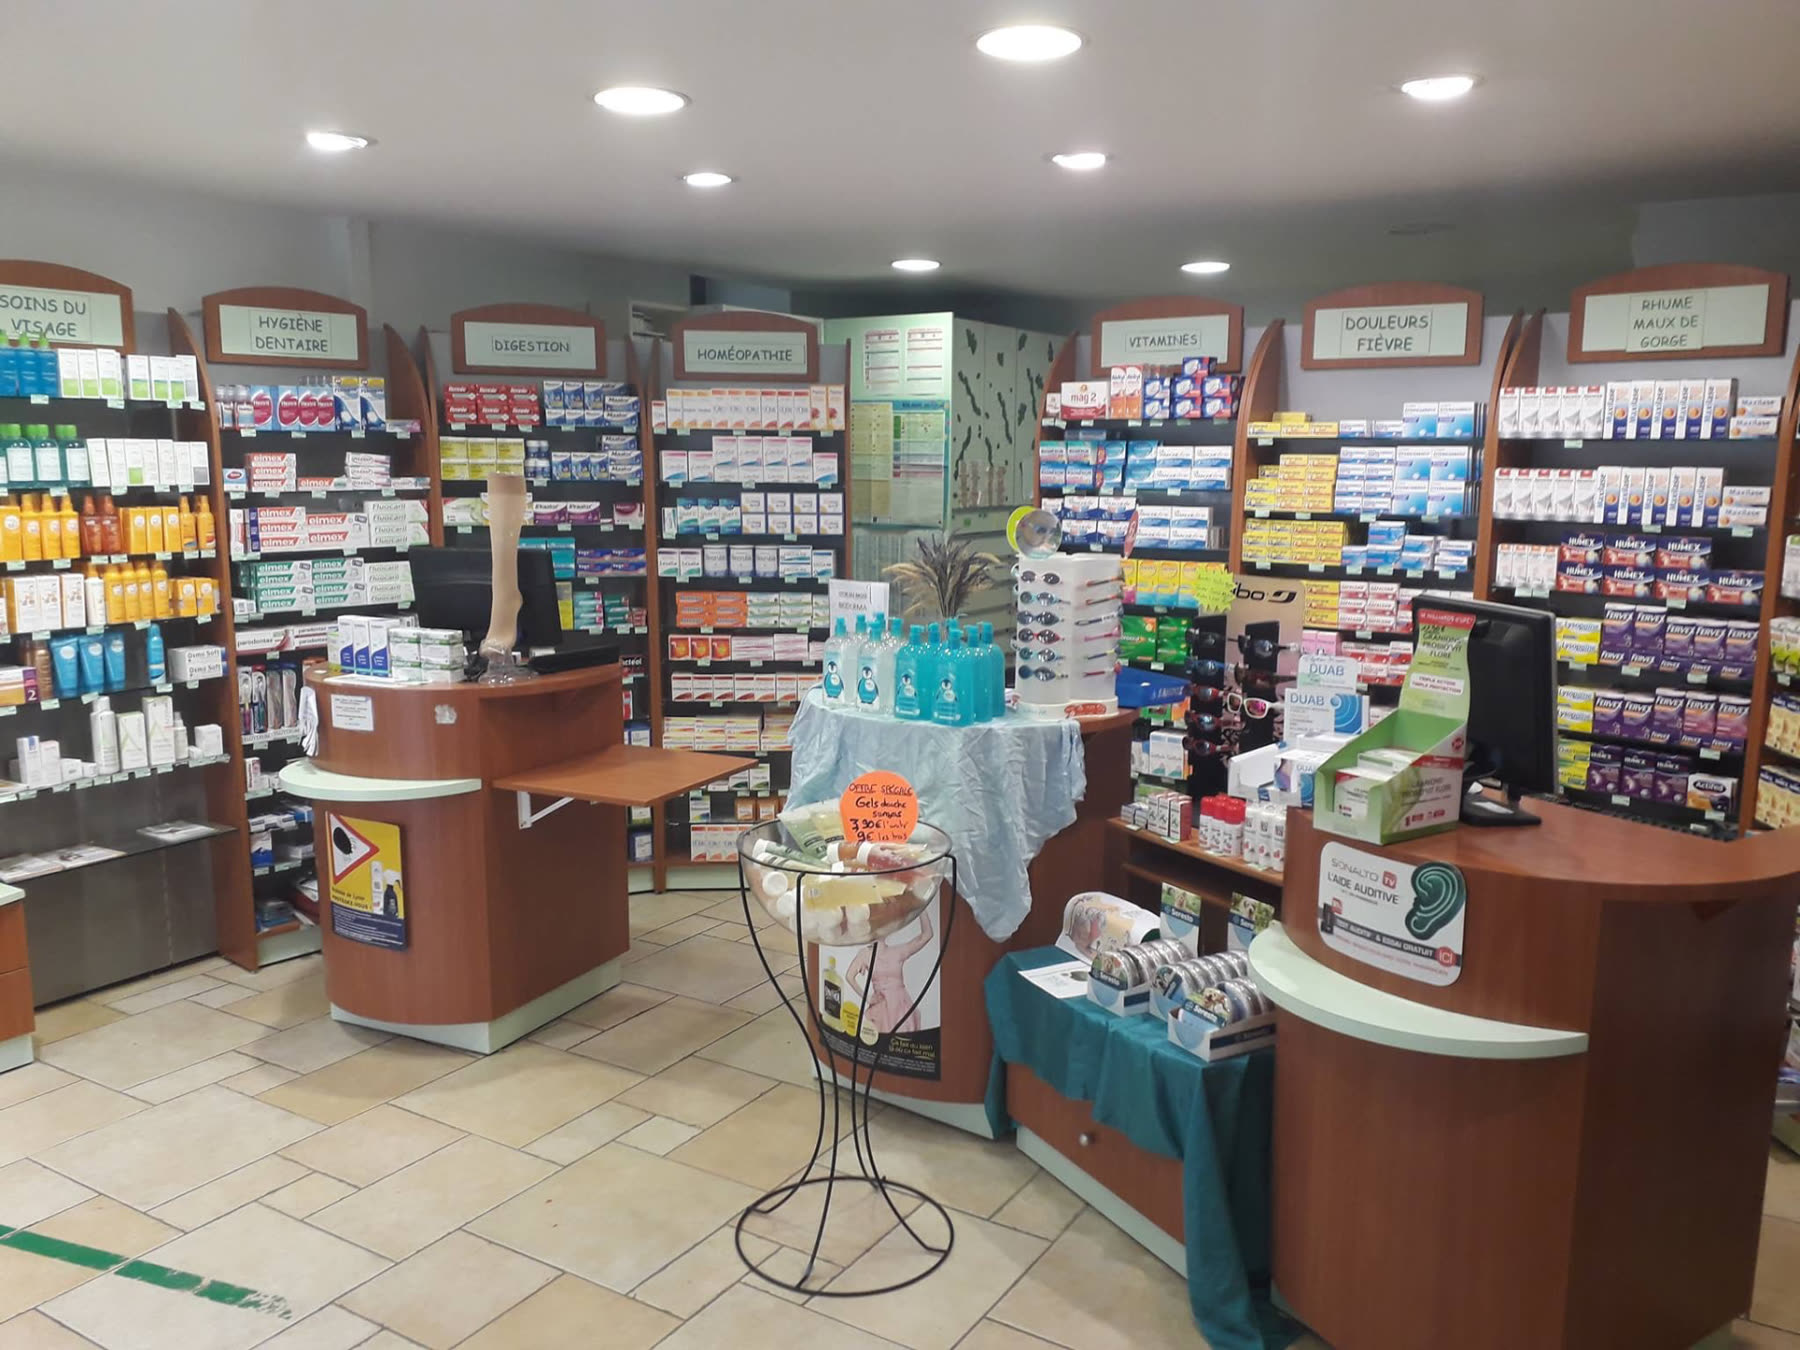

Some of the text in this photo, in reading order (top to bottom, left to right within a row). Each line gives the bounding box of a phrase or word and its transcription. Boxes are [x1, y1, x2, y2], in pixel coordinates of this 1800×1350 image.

[0, 294, 86, 316] SOINS DU
[1641, 296, 1694, 311] RHUME
[12, 317, 77, 338] VISAGE
[259, 313, 323, 333] HYGIÈNE
[1345, 314, 1429, 331] DOULEURS
[1633, 315, 1699, 330] MAUX DE
[255, 336, 328, 353] DENTAIRE
[494, 338, 570, 354] DIGESTION
[1129, 333, 1198, 349] VITAMINES
[1357, 333, 1413, 352] FIÈVRE
[1640, 335, 1689, 349] GORGE
[697, 344, 793, 362] HOMÉOPATHIE
[1071, 392, 1097, 404] mag 2
[254, 454, 283, 462] elmex
[256, 467, 285, 475] elmex
[254, 480, 283, 488] elmex
[301, 479, 331, 487] elmex
[260, 508, 292, 518] elmex
[309, 516, 344, 525] elmex
[262, 524, 294, 533] elmex
[263, 538, 296, 547] elmex
[310, 533, 345, 542] elmex
[1569, 537, 1594, 547] HUMEX
[1616, 539, 1646, 549] HUMEX
[1668, 542, 1701, 552] HUMEX
[259, 564, 290, 572] elmex
[314, 560, 342, 568] elmex
[315, 572, 342, 580] elmex
[1566, 567, 1594, 576] HUMEX
[1614, 570, 1645, 580] HUMEX
[259, 575, 290, 584] elmex
[1667, 573, 1699, 583] HUMEX
[1719, 577, 1752, 587] HUMEX
[262, 588, 292, 597] elmex
[315, 584, 344, 592] elmex
[262, 600, 292, 608] elmex
[316, 596, 344, 604] elmex
[1606, 610, 1633, 621] FERVEX
[1637, 612, 1665, 623] FERVEX
[1667, 624, 1697, 635] FERVEX
[1696, 626, 1726, 637] FERVEX
[1727, 629, 1759, 640] FERVEX
[1601, 651, 1625, 660] FERVEX
[1630, 653, 1656, 663] FERVEX
[1309, 664, 1345, 676] DUAB
[28, 690, 37, 701] 2
[1290, 693, 1325, 706] DUAB
[1596, 698, 1621, 709] FERVEX
[1656, 696, 1684, 707] FERVEX
[1686, 699, 1715, 711] FERVEX
[1625, 702, 1652, 713] FERVEX
[1719, 703, 1749, 714] FERVEX
[856, 796, 907, 808] Gels douche
[1331, 858, 1396, 889] SONALTO TV
[1327, 871, 1351, 889] L'AIDE
[1353, 882, 1399, 905] AUDITIVE
[1171, 908, 1193, 923] Seresto
[1383, 938, 1402, 948] ESSAI
[1403, 943, 1433, 957] GRATUIT
[1439, 953, 1453, 963] ICI
[1100, 971, 1121, 986] Seresto
[1193, 1004, 1218, 1023] Seresto
